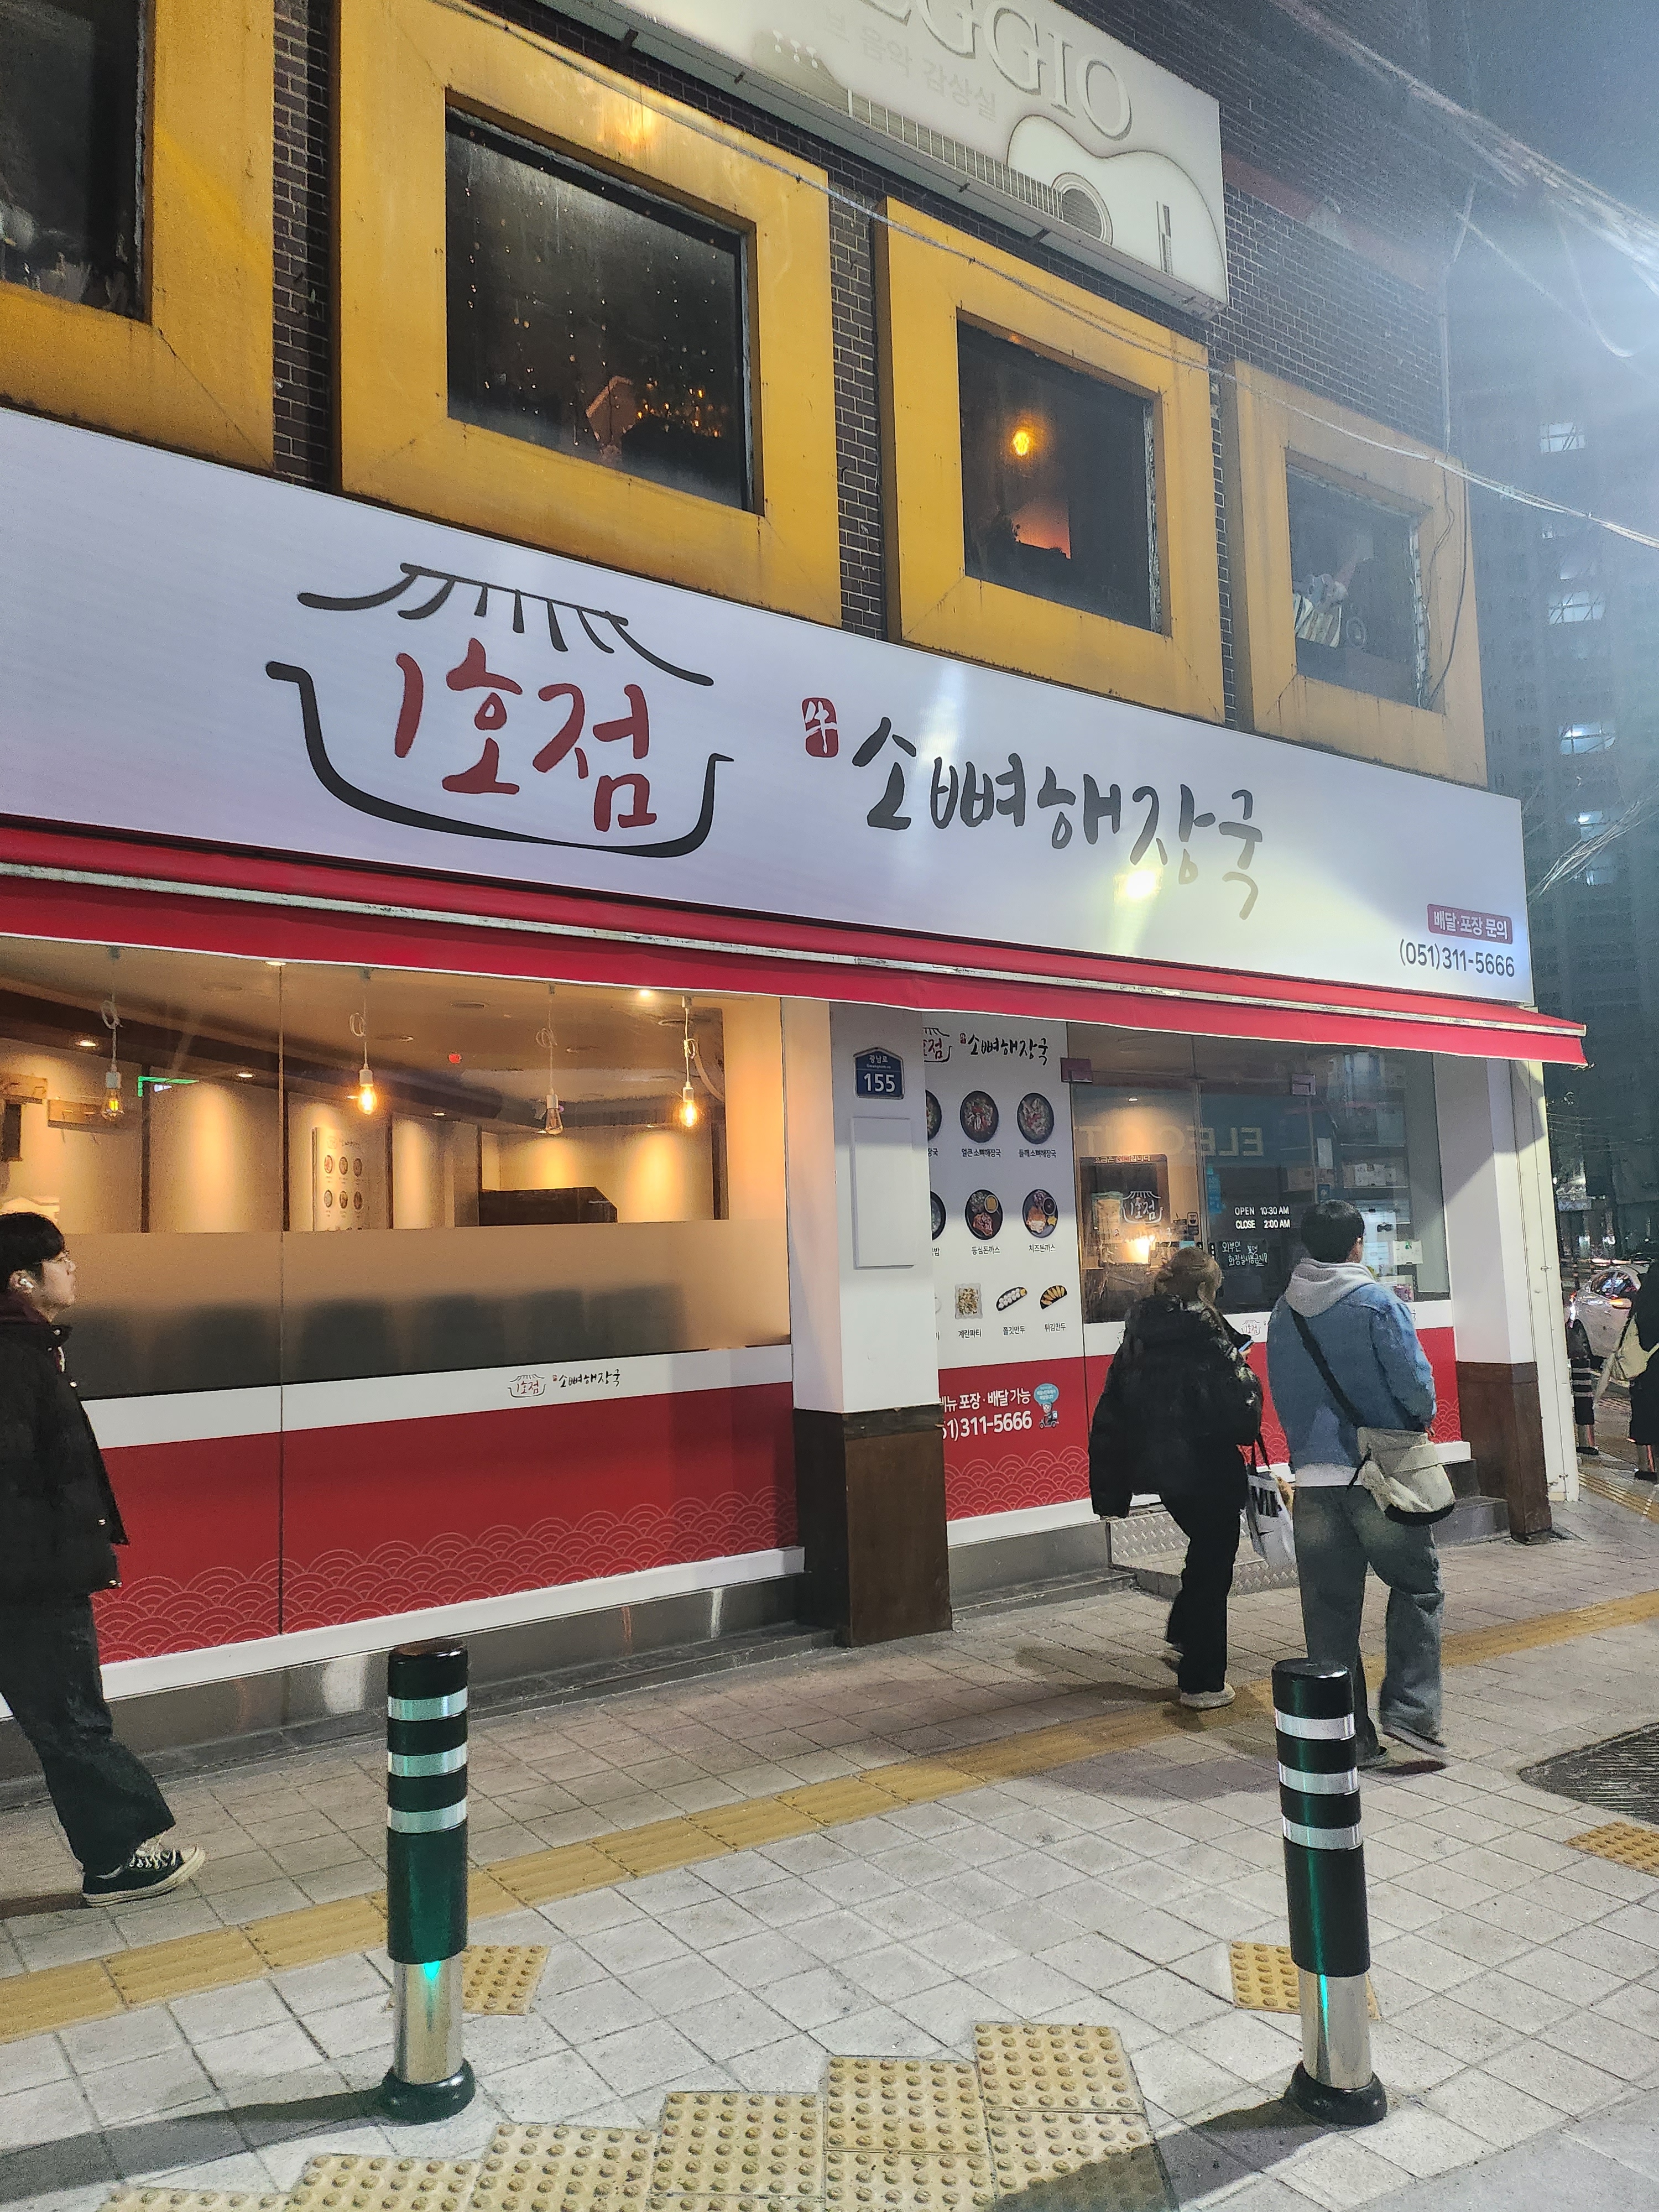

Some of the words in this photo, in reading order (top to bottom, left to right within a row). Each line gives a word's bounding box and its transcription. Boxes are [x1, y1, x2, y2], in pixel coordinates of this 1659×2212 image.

[394, 638, 657, 832] 1호점
[852, 717, 1263, 921] 소뼈해장국
[1485, 918, 1508, 940] 문의
[1400, 938, 1515, 978] (051)311-5666
[968, 1034, 1048, 1066] 소뼈해장국
[869, 1054, 889, 1064] 광남로
[864, 1073, 896, 1093] 155
[961, 1148, 973, 1157] 얼큰
[1234, 1207, 1255, 1215] OPEN
[1260, 1206, 1277, 1215] 10:30
[1279, 1206, 1290, 1215] AM
[1235, 1220, 1256, 1229] CLOSE
[1264, 1220, 1279, 1229] 2:00
[1279, 1219, 1291, 1228] AM
[971, 1245, 1001, 1255] 등심돈까스
[1028, 1244, 1056, 1253] 치즈돈까스
[1222, 1240, 1241, 1253] 외부인
[1044, 1323, 1067, 1332] 튀김만두
[558, 1369, 620, 1388] 소뼈해장국
[987, 1389, 1009, 1407] 배달
[1010, 1387, 1031, 1405] 가능
